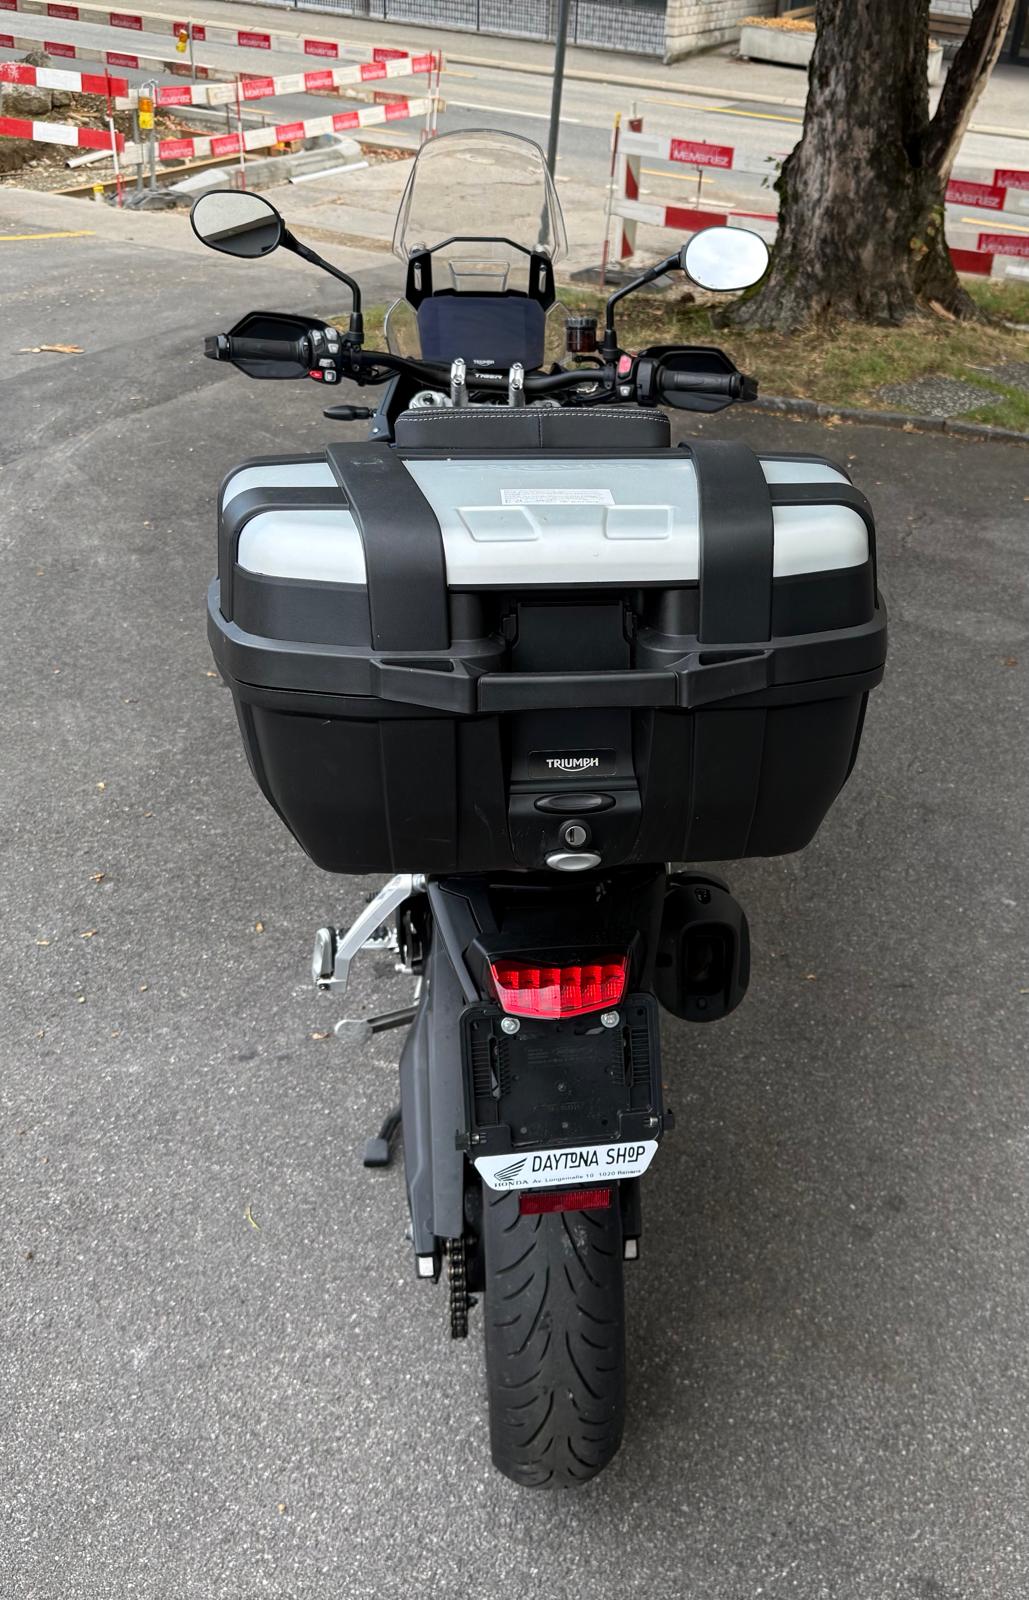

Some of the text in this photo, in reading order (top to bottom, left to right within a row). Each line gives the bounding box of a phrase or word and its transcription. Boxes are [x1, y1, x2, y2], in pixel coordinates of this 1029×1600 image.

[546, 757, 599, 772] TRIUMPH
[532, 1145, 646, 1173] DAYTONA SHOP
[494, 1180, 529, 1188] HONDA
